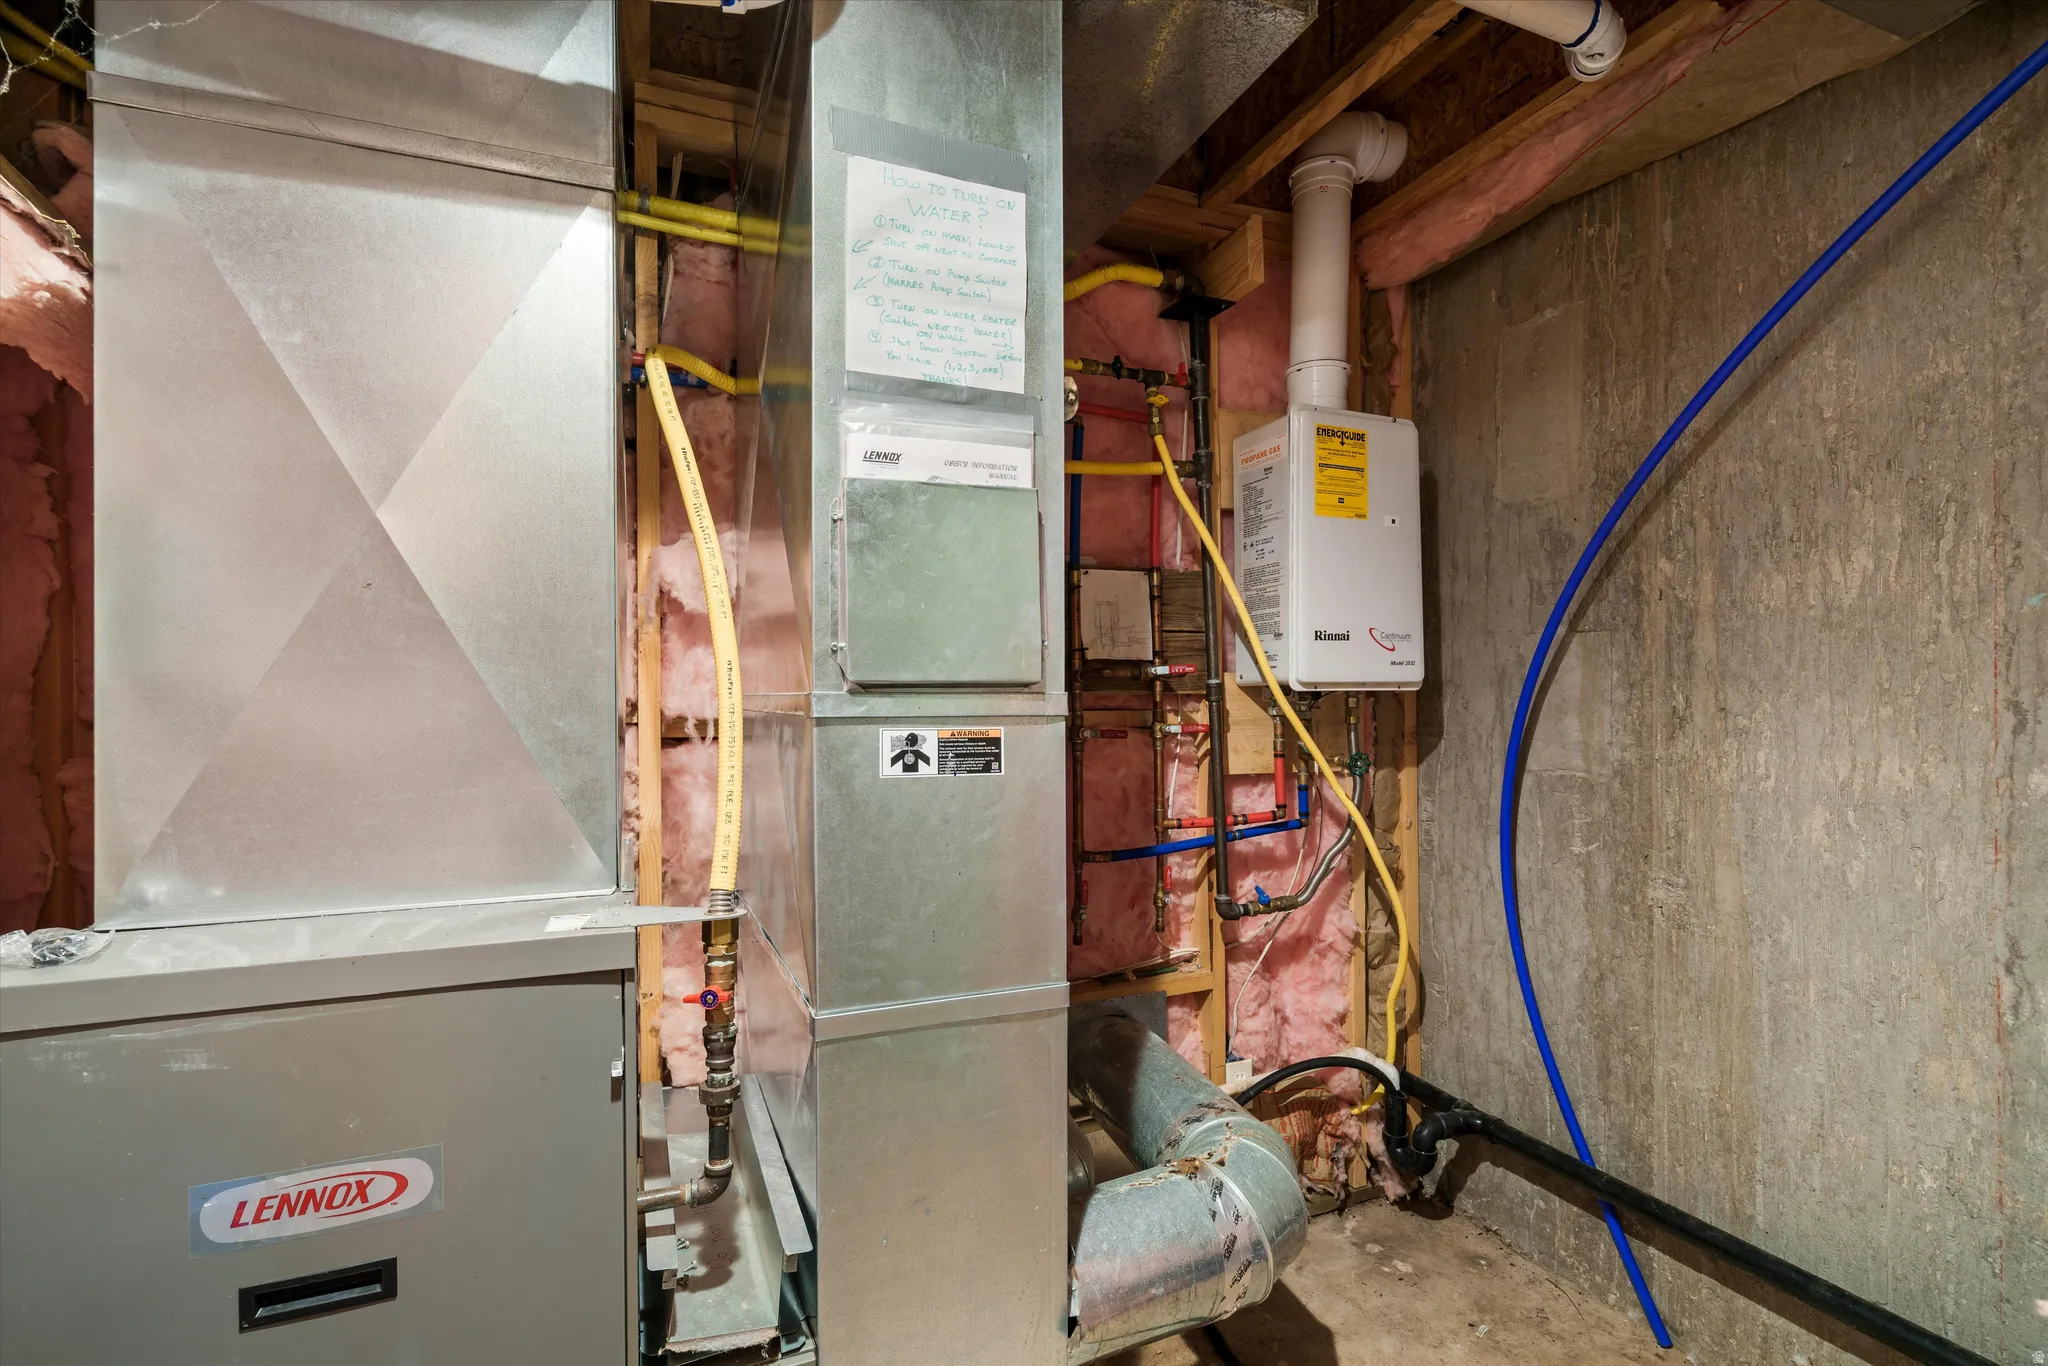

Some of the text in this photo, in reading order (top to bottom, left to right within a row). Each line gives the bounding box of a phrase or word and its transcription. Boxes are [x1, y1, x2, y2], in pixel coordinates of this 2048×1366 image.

[928, 182, 946, 196] TO
[953, 188, 988, 205] TURN
[996, 199, 1016, 211] ON
[889, 217, 914, 234] TURN
[922, 229, 937, 237] ON
[889, 259, 917, 273] TURN
[890, 299, 916, 312] TURN
[982, 314, 1017, 327] HEATER
[863, 450, 902, 462] LENNOX
[1242, 450, 1267, 465] PROPANE
[1269, 445, 1280, 455] GAS
[988, 472, 1018, 481] MANUAL
[1314, 630, 1350, 641] Rinnai
[1380, 631, 1411, 640] Continuum
[229, 1177, 375, 1229] LENNOX
